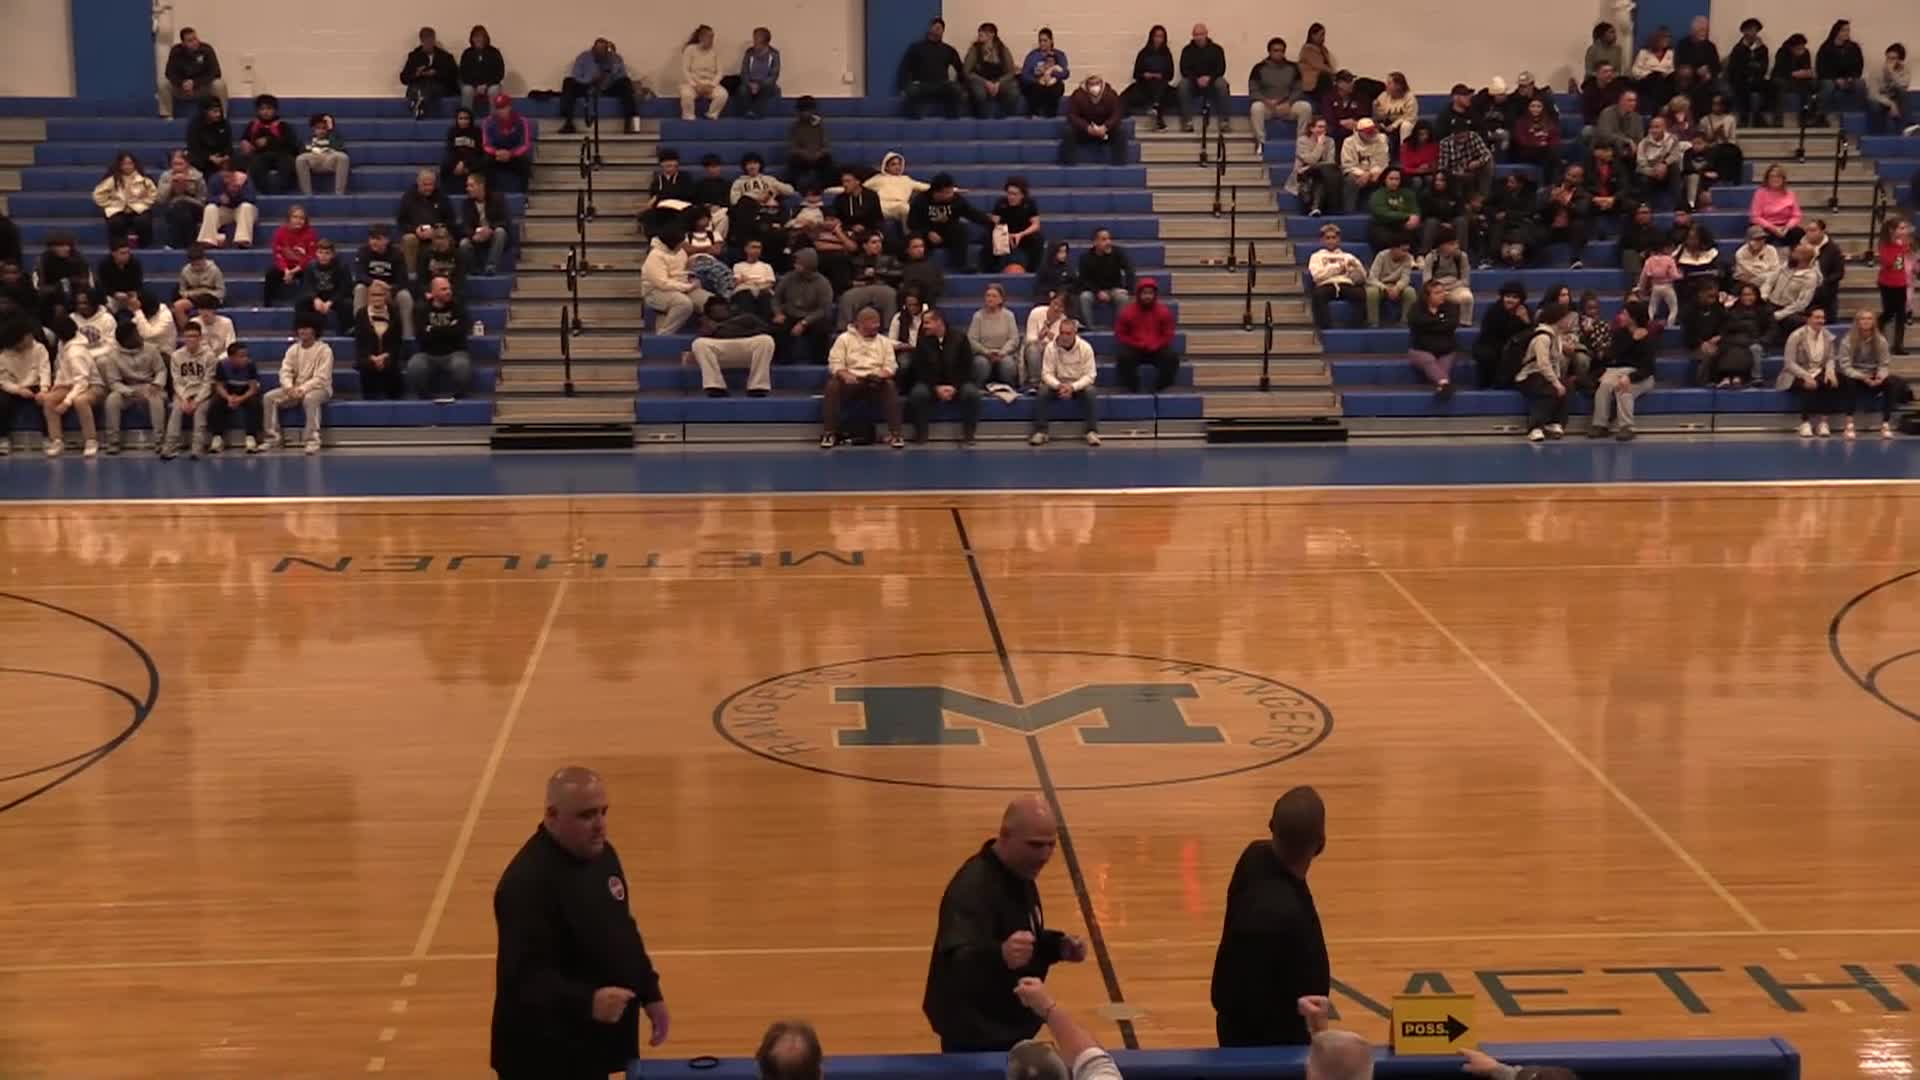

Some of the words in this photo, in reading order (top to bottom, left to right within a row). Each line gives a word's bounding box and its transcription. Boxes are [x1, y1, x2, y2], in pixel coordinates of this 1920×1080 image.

[272, 550, 864, 573] METHUEN
[732, 669, 857, 756] RANGERS
[830, 683, 1232, 746] M
[1159, 664, 1315, 748] RANGERS
[1328, 964, 1920, 1020] METH
